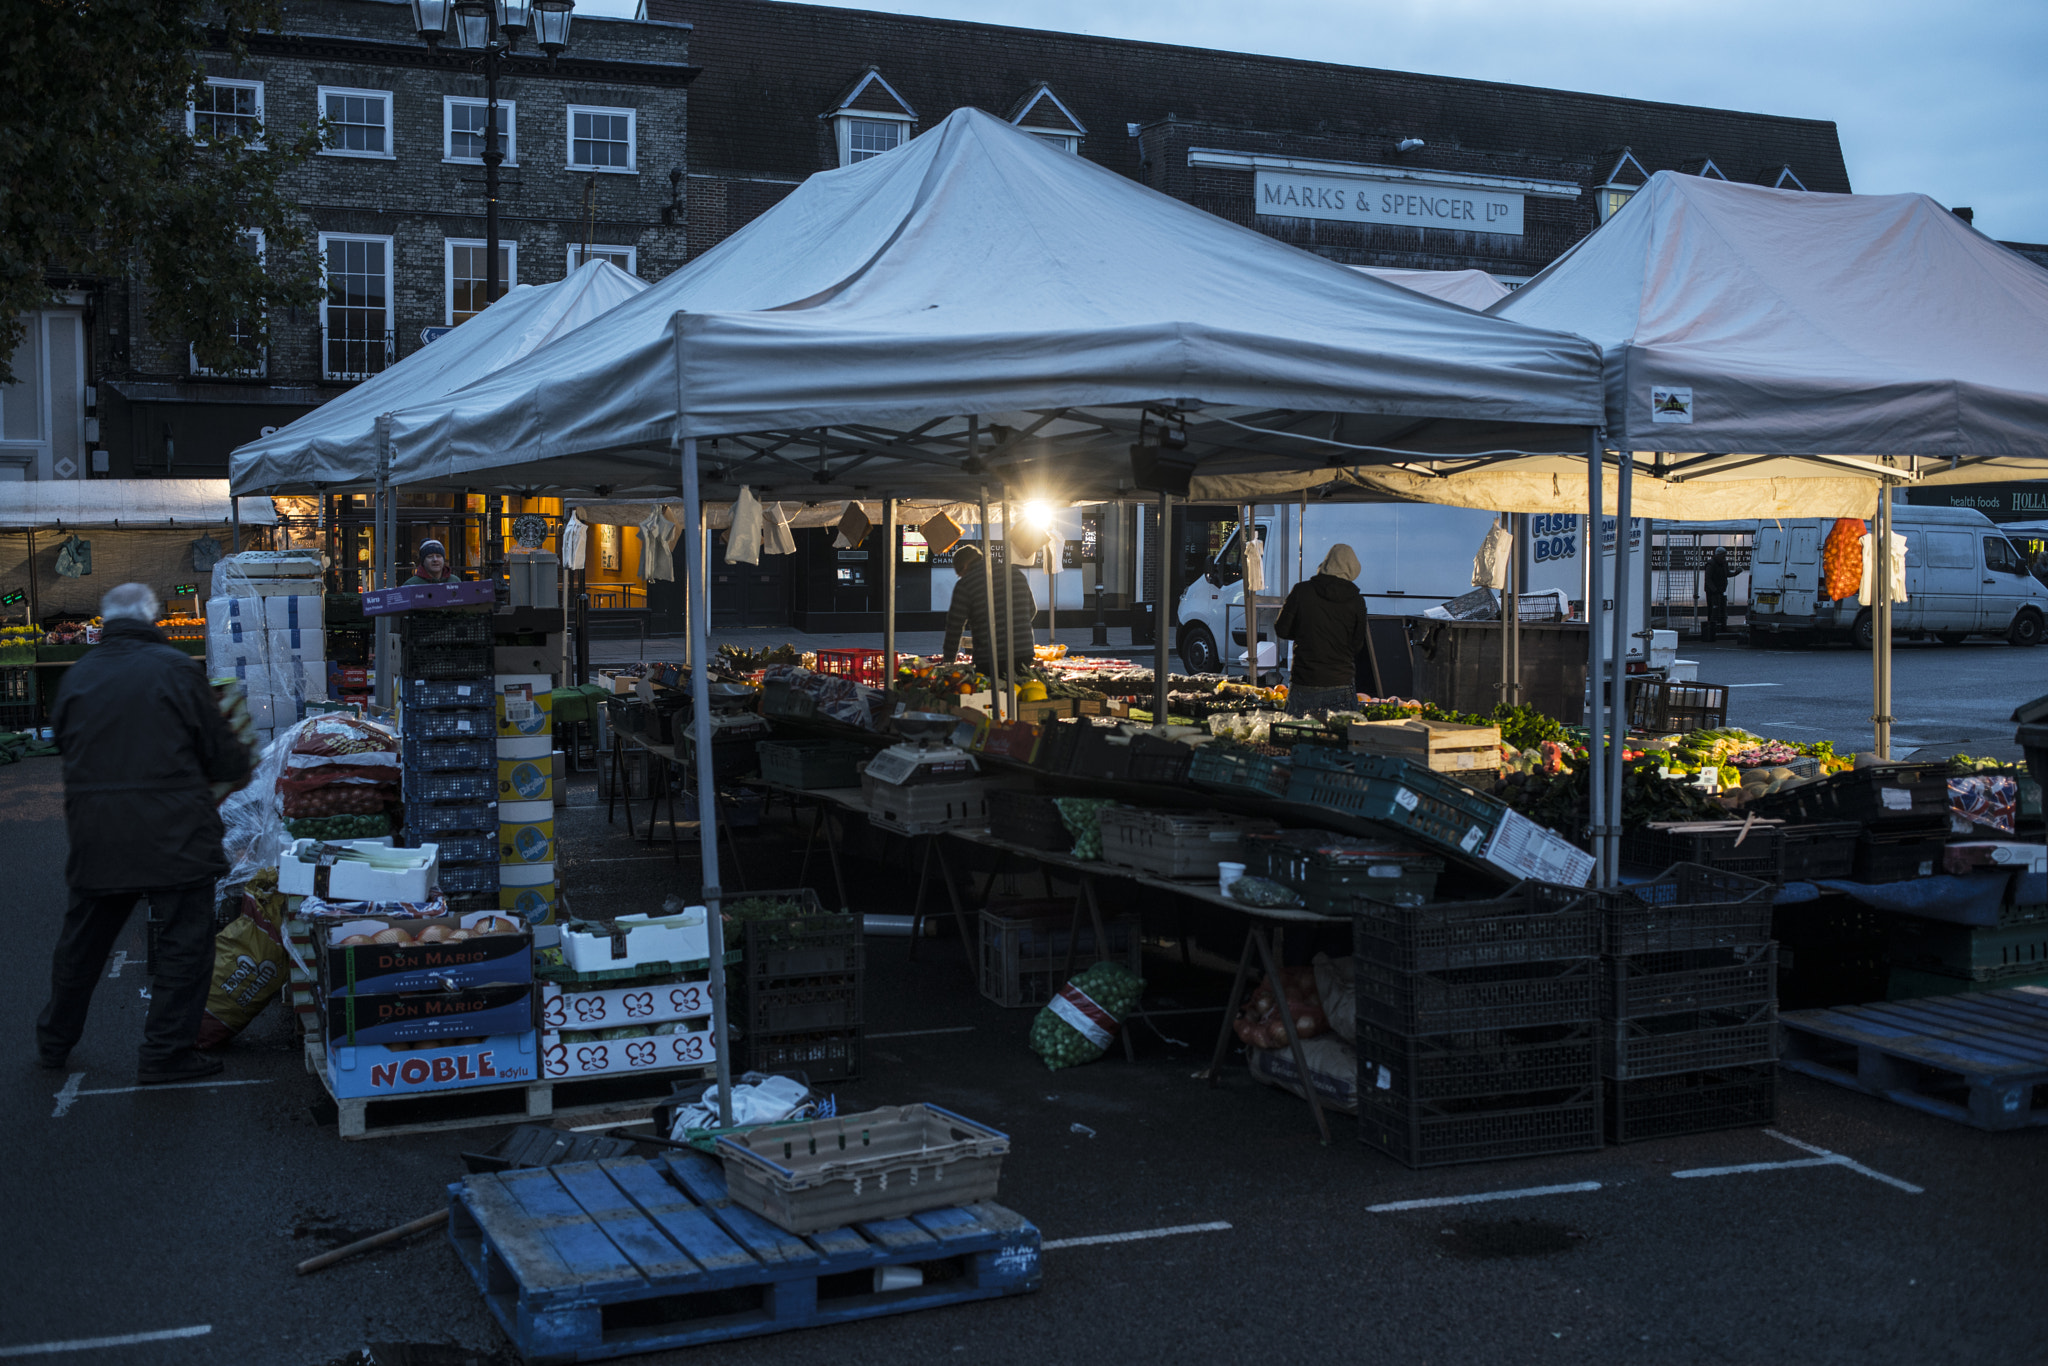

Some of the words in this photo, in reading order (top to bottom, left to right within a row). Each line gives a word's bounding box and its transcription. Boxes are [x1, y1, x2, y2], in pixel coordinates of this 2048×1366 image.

[1264, 183, 1345, 209] MARKS
[1356, 191, 1371, 211] &
[1382, 193, 1475, 220] SPENCER
[1951, 496, 1976, 507] health
[1977, 496, 2000, 508] foods
[2012, 492, 2048, 511] HOLLA
[1534, 514, 1577, 536] FISH
[1535, 536, 1576, 562] BOX
[378, 954, 418, 969] DON
[425, 951, 484, 965] MARIO
[221, 954, 259, 994] CHOICE
[378, 1003, 418, 1018] DON
[425, 1000, 484, 1014] MARIO
[371, 1050, 496, 1089] NOBLE
